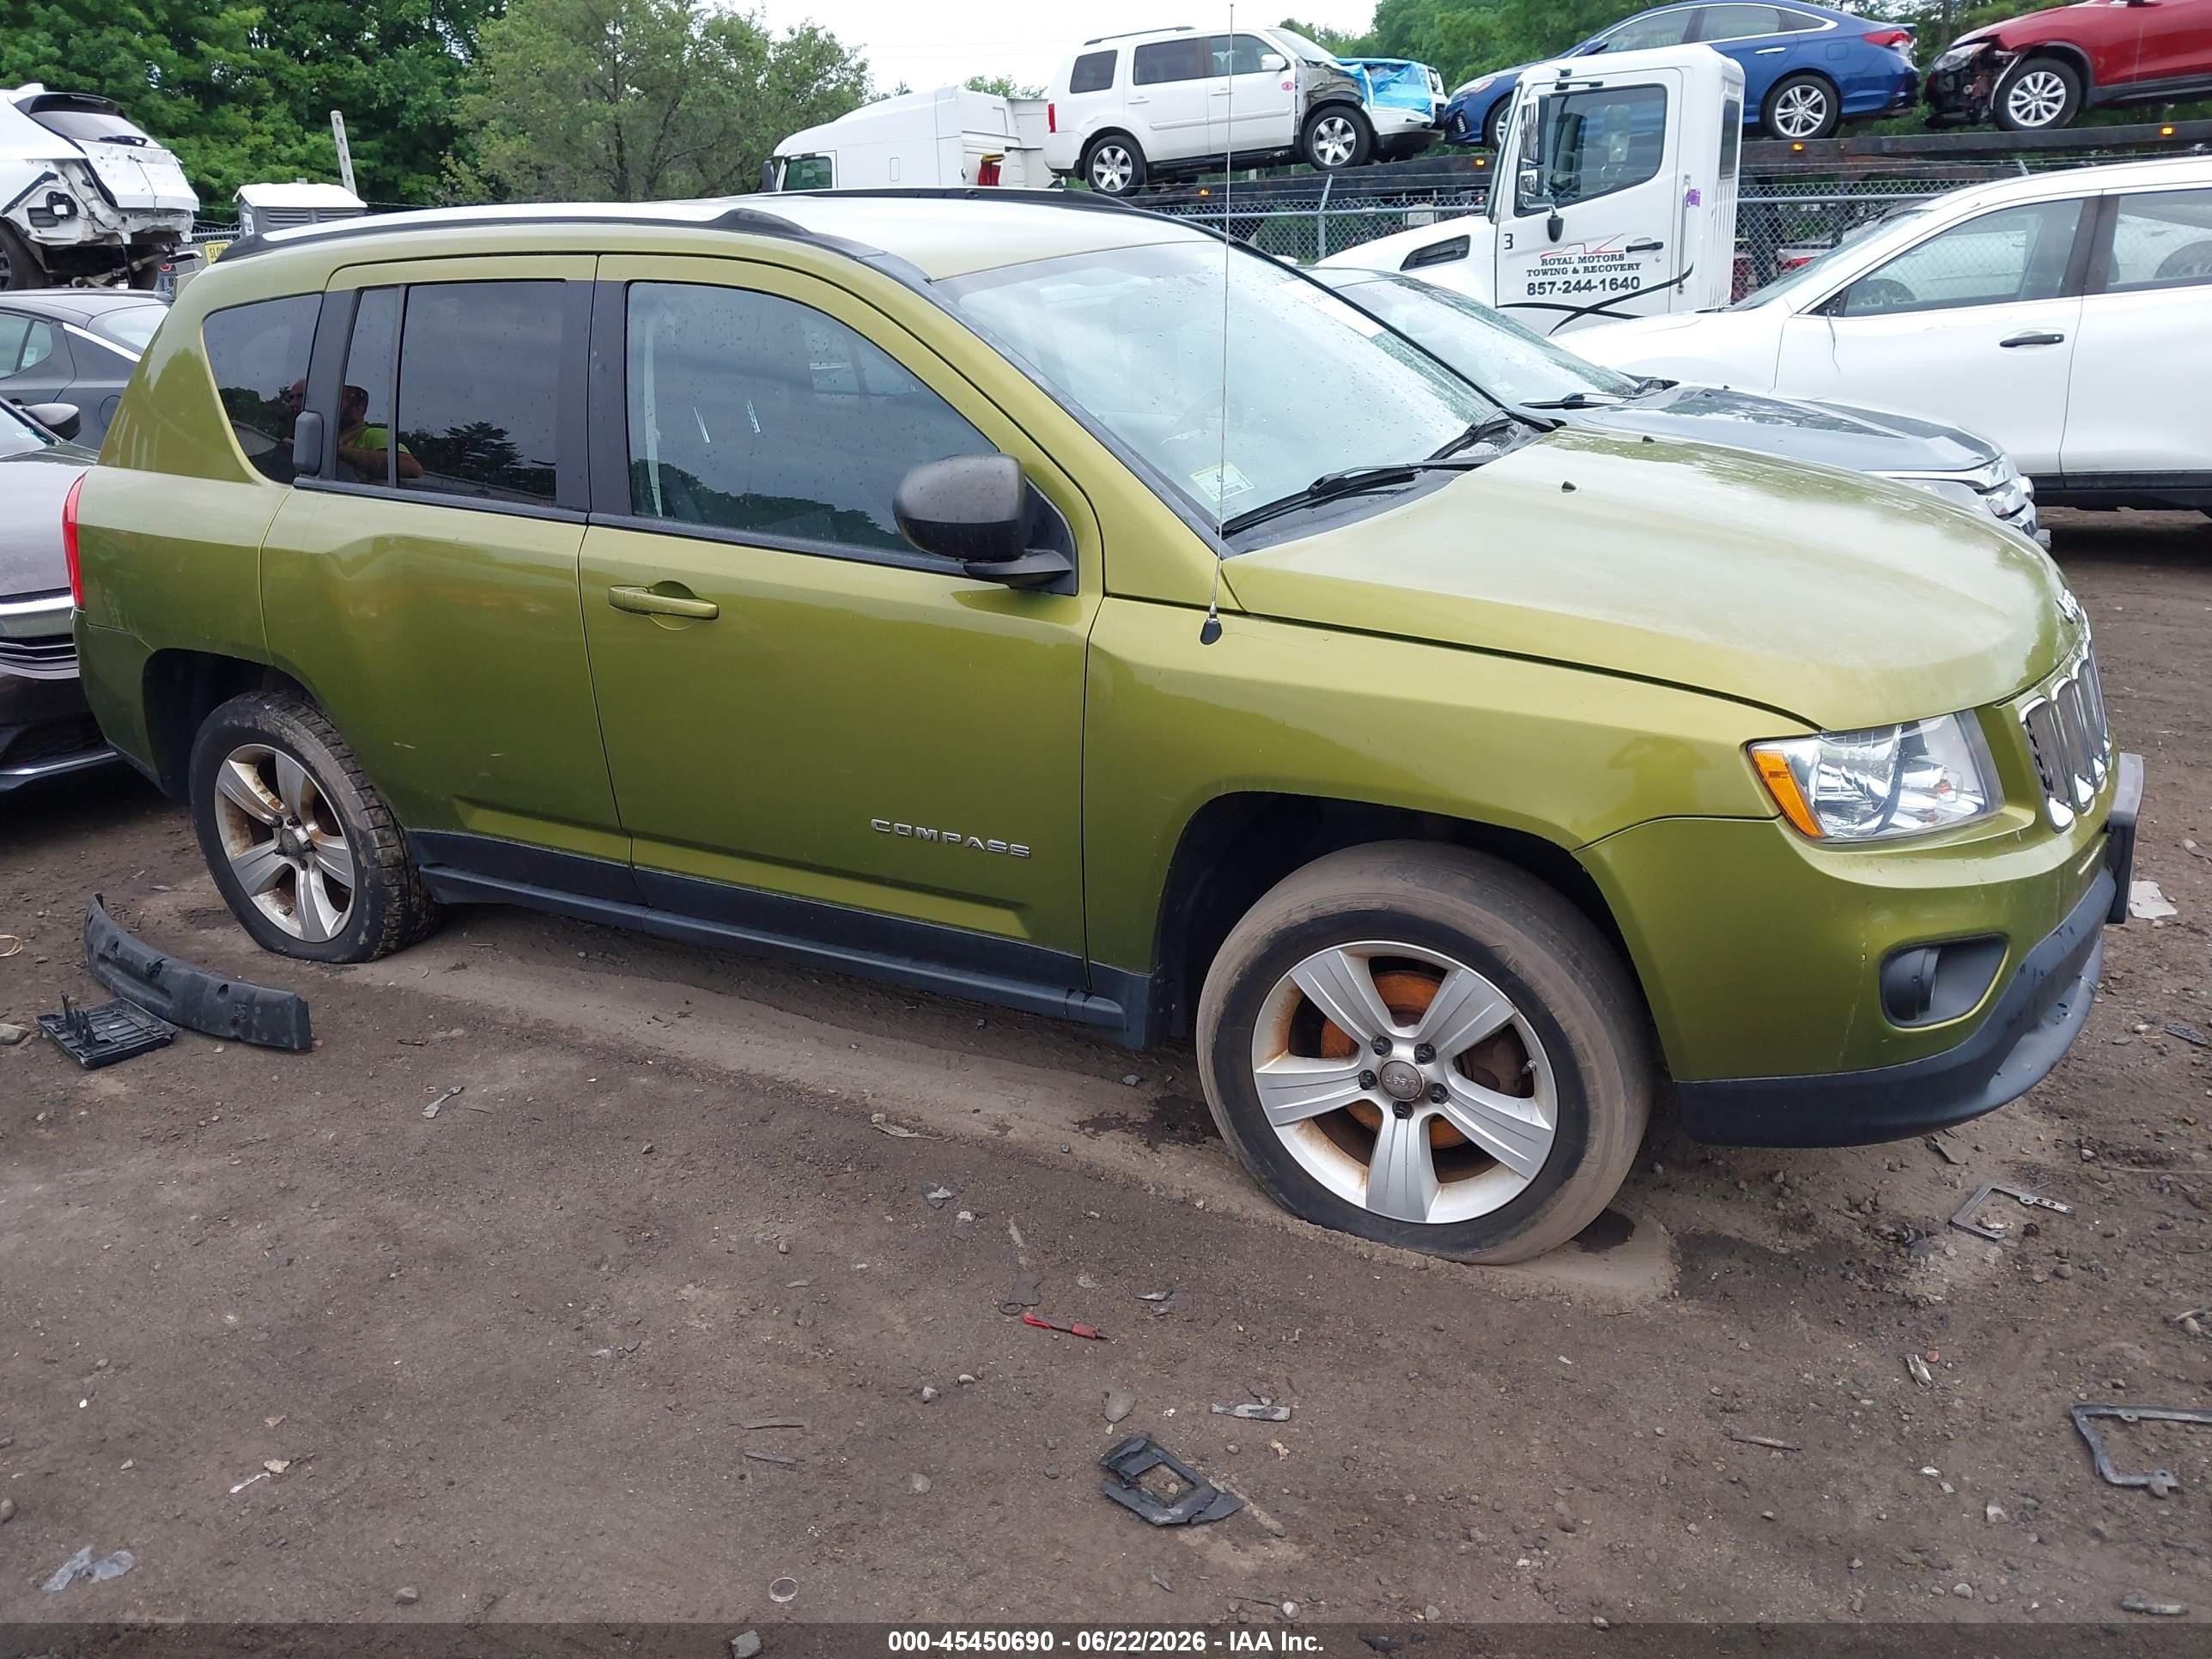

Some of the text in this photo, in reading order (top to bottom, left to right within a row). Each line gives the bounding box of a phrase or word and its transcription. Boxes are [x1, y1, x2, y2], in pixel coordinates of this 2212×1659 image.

[1504, 233, 1514, 250] 3
[1540, 252, 1626, 266] ROYAL MOTORS
[1526, 262, 1642, 277] TOWING & RECOVERY
[1526, 276, 1641, 296] 857-244-1640
[870, 817, 1031, 859] COMPASS
